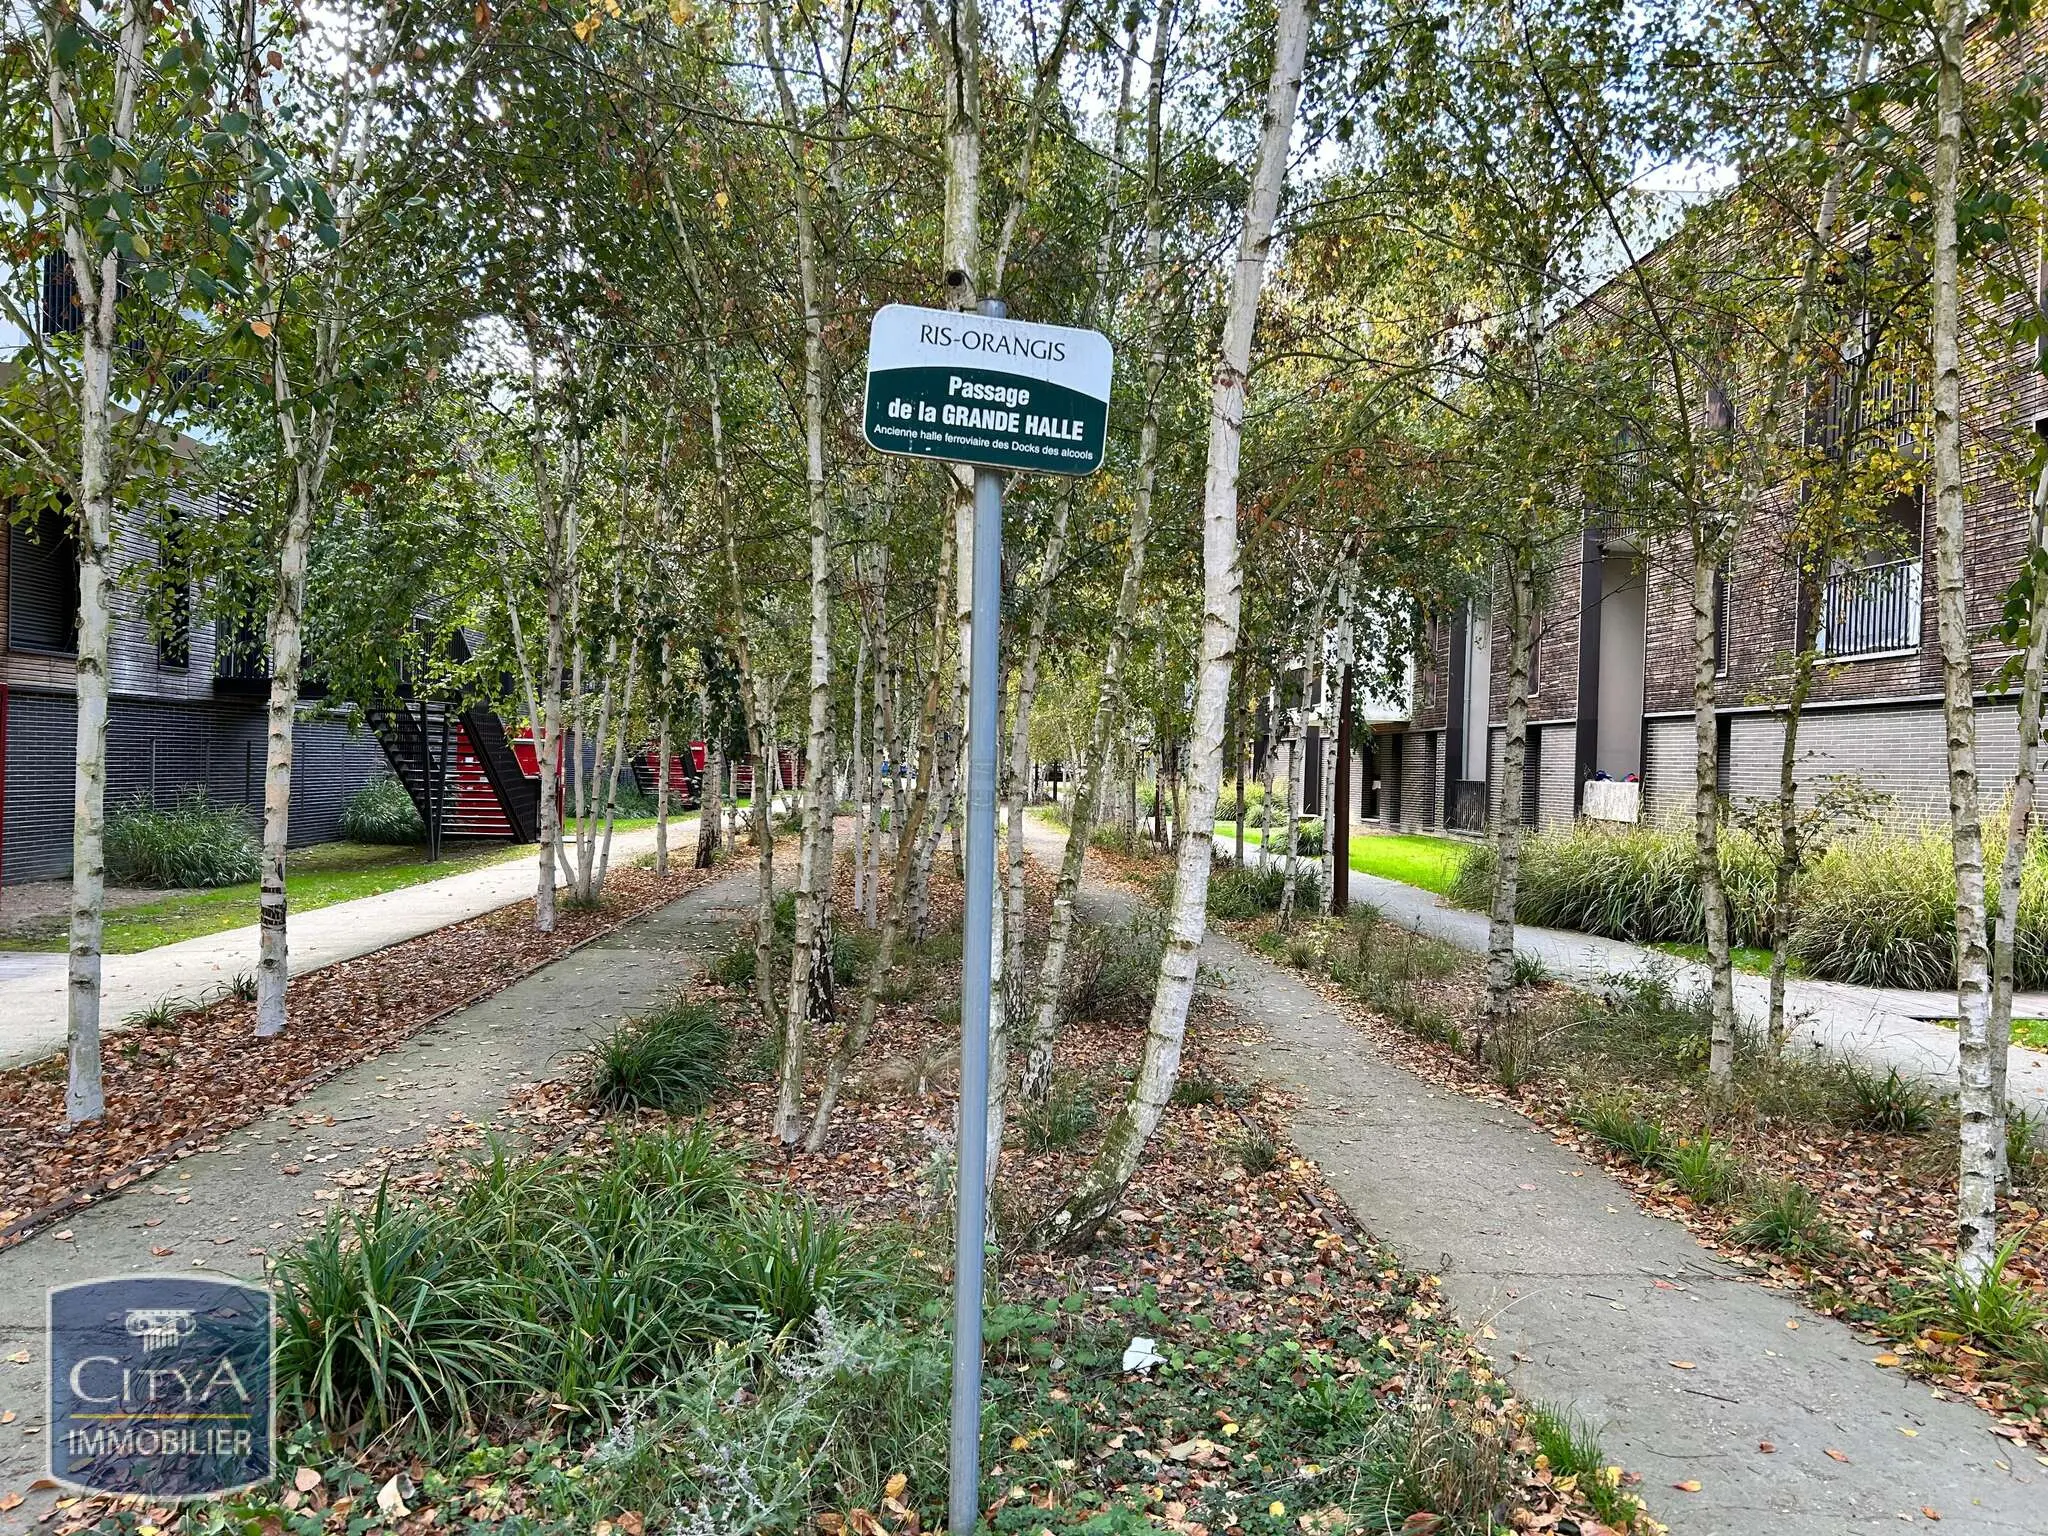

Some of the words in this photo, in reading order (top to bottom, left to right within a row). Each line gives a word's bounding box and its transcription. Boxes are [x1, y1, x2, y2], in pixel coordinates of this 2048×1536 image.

[920, 324, 1066, 362] RIS-ORANGIS
[948, 375, 1030, 408] Passage
[888, 398, 912, 420] de
[918, 401, 937, 423] la
[942, 404, 1020, 433] GRANDE
[1025, 414, 1084, 441] HALLE
[873, 424, 918, 439] Ancienne
[920, 430, 943, 442] halle
[944, 433, 991, 448] ferroviaire
[992, 439, 1009, 450] des
[1011, 441, 1040, 454] Docks
[1042, 445, 1059, 456] des
[1061, 448, 1093, 460] alcools
